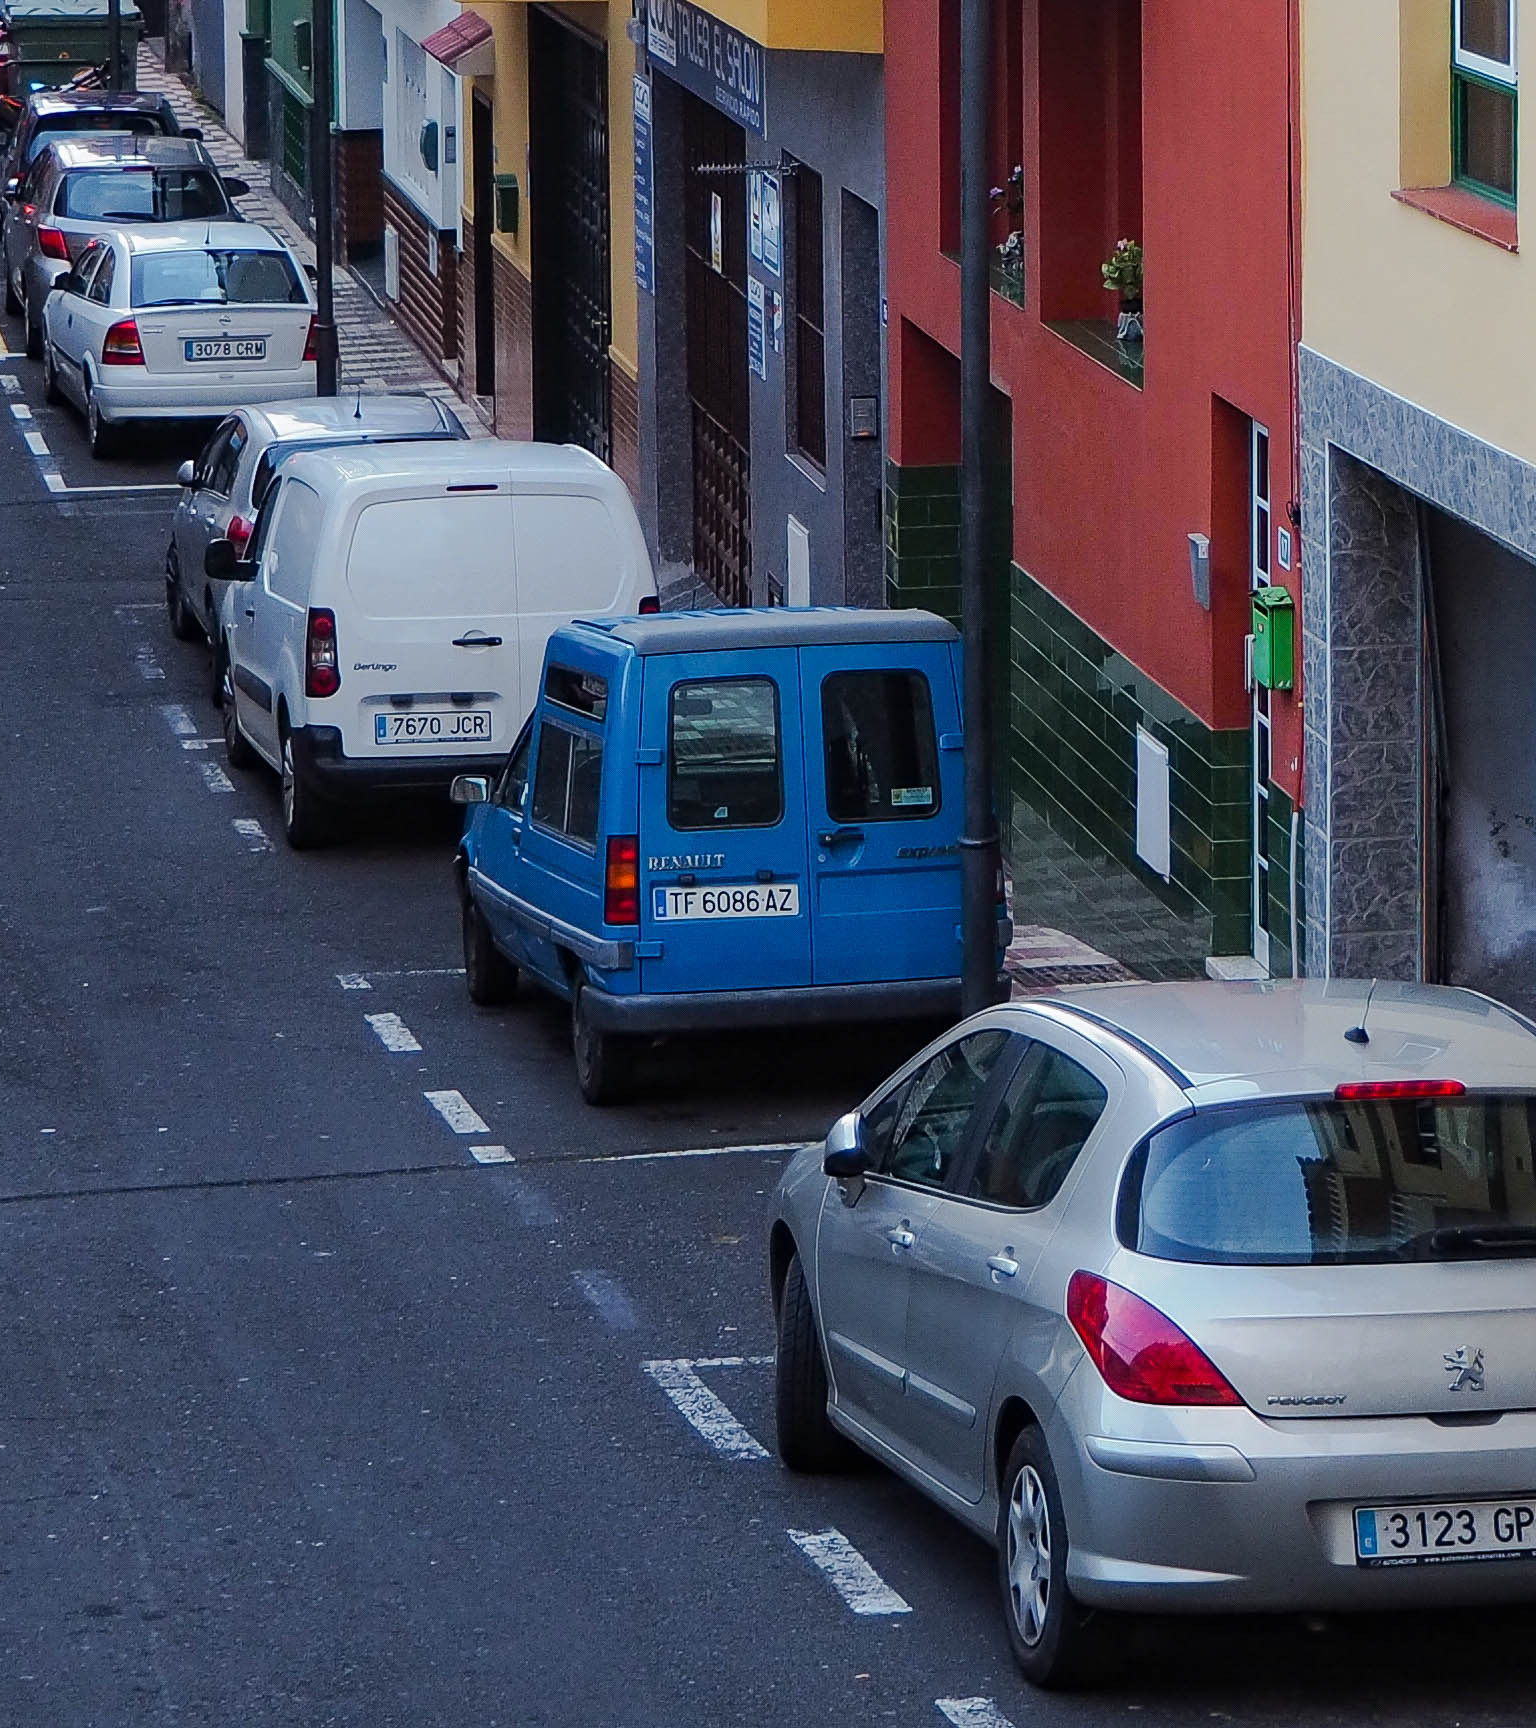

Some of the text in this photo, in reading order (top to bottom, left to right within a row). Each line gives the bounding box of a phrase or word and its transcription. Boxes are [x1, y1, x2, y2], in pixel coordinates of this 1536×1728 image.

[195, 341, 264, 357] 3078 CRM
[393, 715, 485, 736] 7670 JCR
[648, 853, 725, 871] RENAULT
[669, 888, 793, 915] TF 6086 AZ
[1267, 1394, 1347, 1406] PEUGEOT
[1389, 1509, 1477, 1548] 3123
